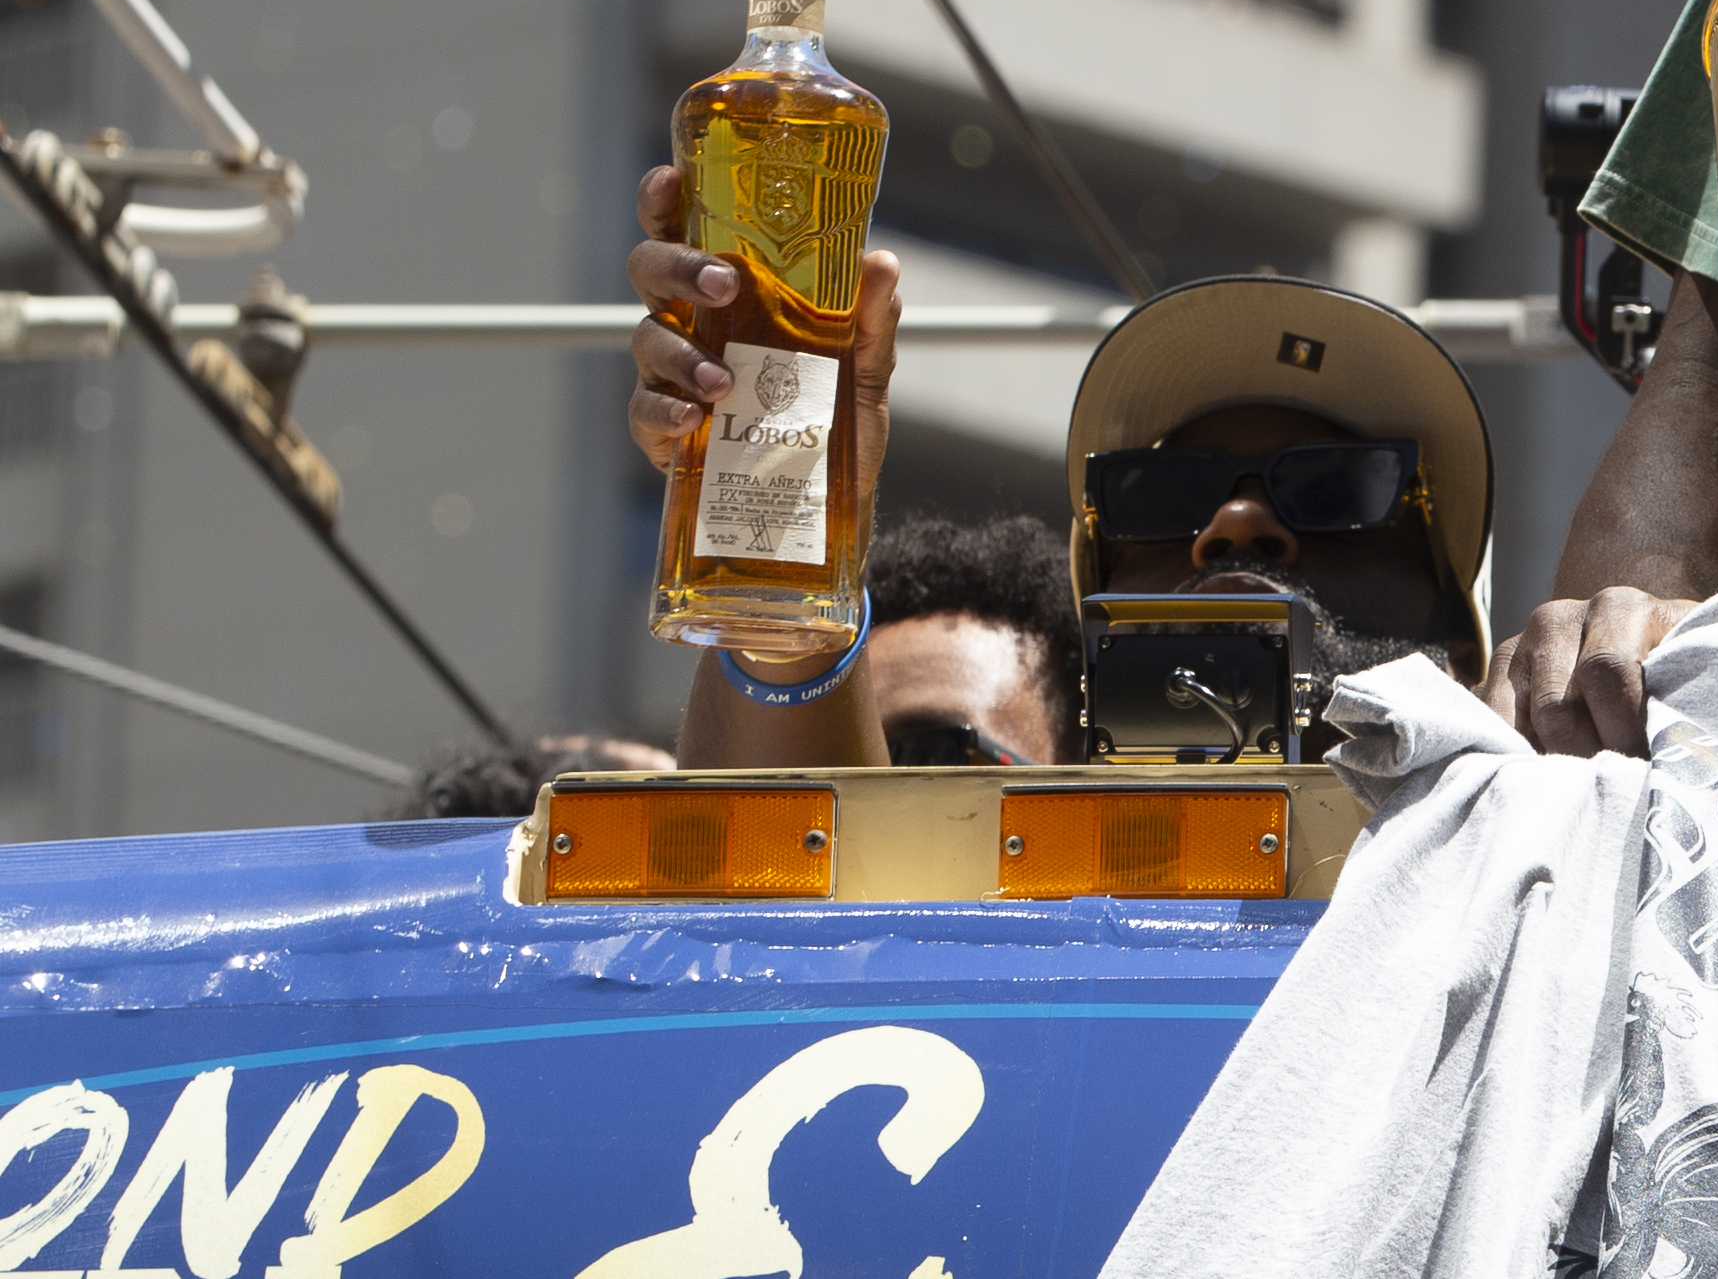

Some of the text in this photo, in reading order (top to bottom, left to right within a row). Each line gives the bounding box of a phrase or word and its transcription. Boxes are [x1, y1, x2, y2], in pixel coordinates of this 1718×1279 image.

[759, 14, 782, 24] 1707
[719, 413, 823, 449] LOBOS
[717, 472, 812, 491] EXTRA AÑEJO
[719, 488, 739, 502] PX
[744, 684, 754, 696] I
[765, 693, 790, 703] AM
